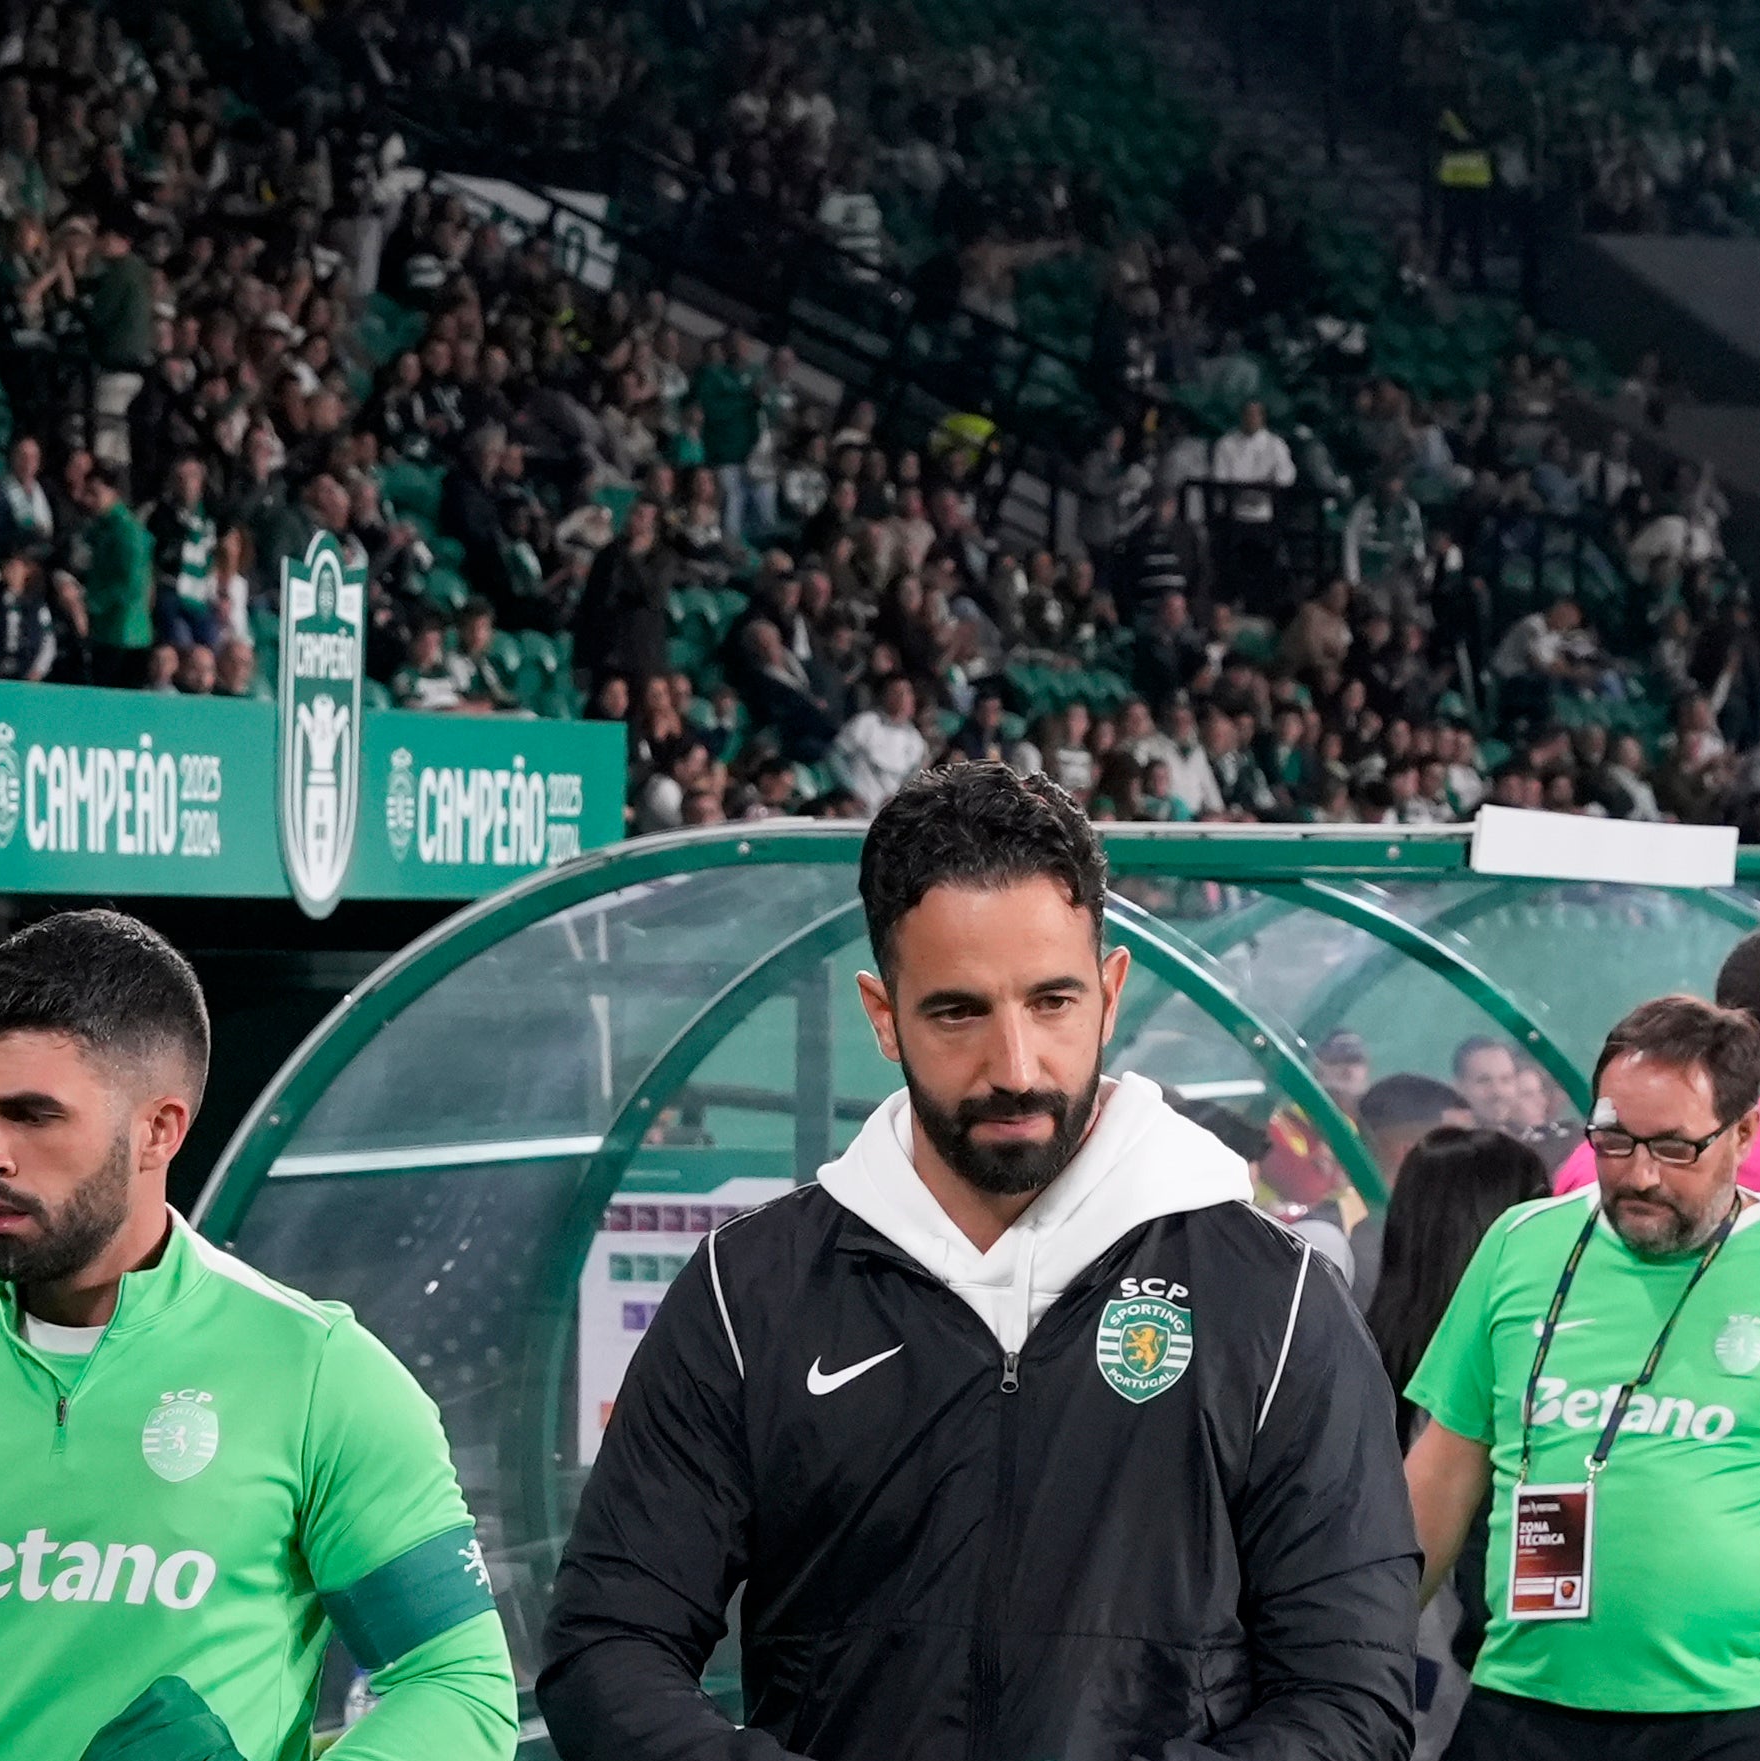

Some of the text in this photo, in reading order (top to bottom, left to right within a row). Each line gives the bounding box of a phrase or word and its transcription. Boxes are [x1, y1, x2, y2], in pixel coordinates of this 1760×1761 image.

[25, 732, 178, 855] CAMPEÃO
[180, 754, 222, 801] 2023
[417, 754, 546, 866] CAMPEÃO
[180, 809, 221, 857] 2024
[1119, 1277, 1189, 1301] SCP
[1109, 1303, 1187, 1332] SPORTING
[160, 1389, 214, 1404] SCP
[1107, 1367, 1177, 1390] PORTUGAL
[1522, 1376, 1736, 1443] Betano
[1519, 1521, 1550, 1534] ZONA
